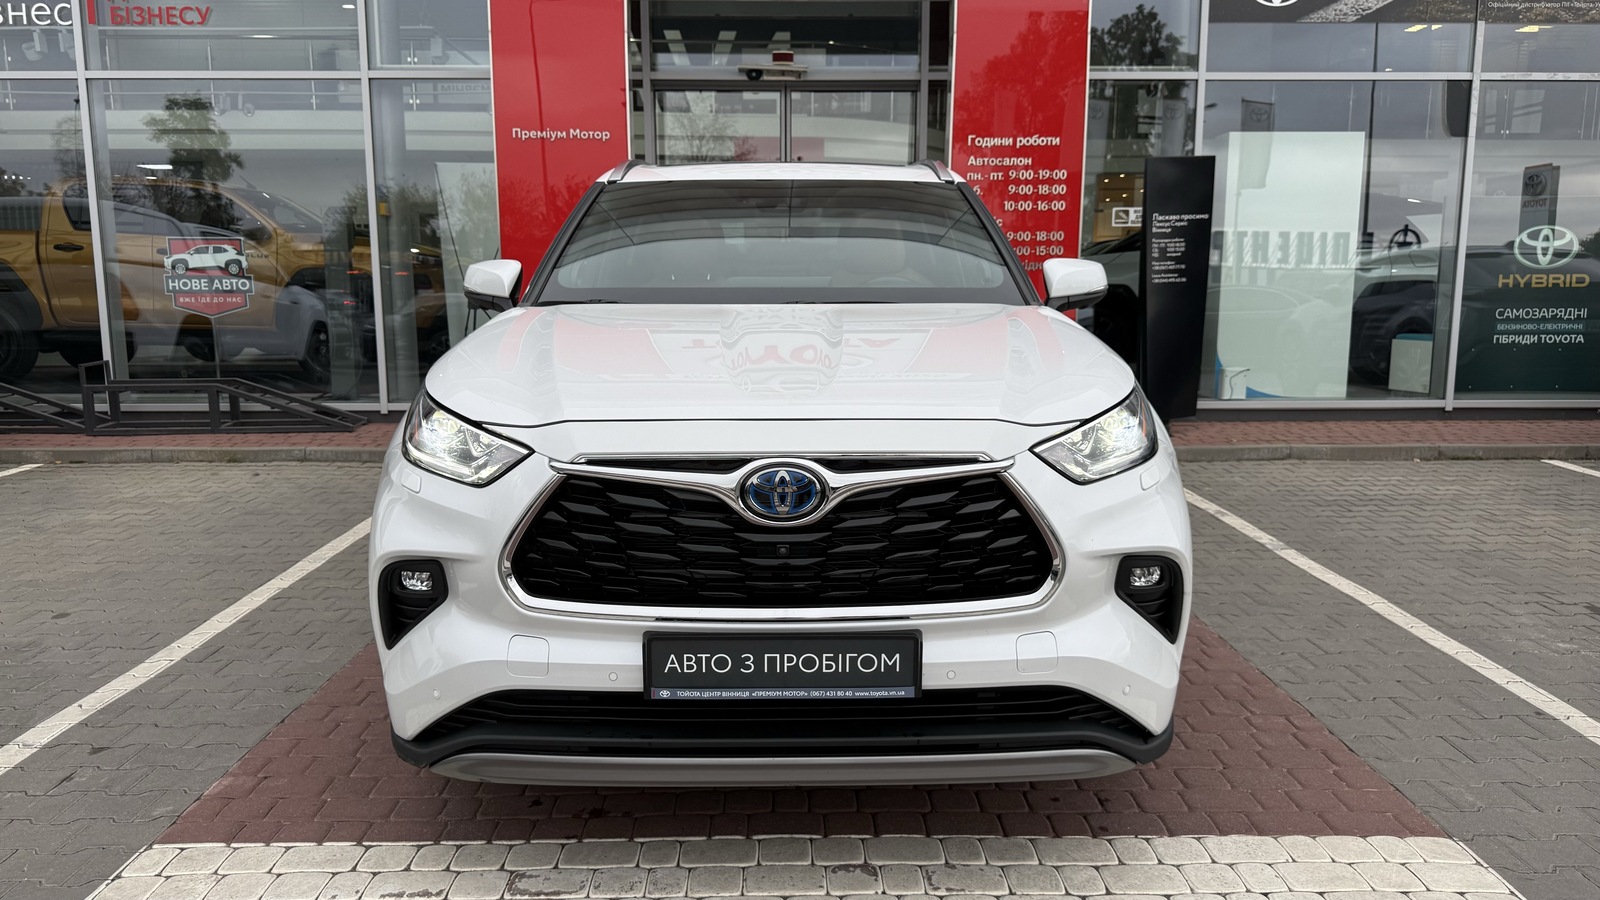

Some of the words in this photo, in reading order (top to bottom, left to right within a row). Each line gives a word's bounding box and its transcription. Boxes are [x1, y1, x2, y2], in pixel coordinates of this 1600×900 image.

[0, 3, 73, 25] нес
[110, 6, 211, 25] БІЗНЕСУ
[512, 128, 566, 141] Преміум
[569, 128, 610, 141] Мотор
[967, 135, 1013, 147] Години
[1016, 135, 1060, 148] роботи
[968, 156, 1032, 166] Автосалон
[1009, 169, 1068, 180] 9:00-19:00
[972, 184, 983, 195] б.
[1008, 184, 1067, 195] 9:00-18:00
[1003, 200, 1066, 211] 10:00-16:00
[1181, 213, 1209, 221] просимо
[1006, 231, 1065, 242] 9:00-18:00
[1012, 245, 1064, 256] :00-15:00
[168, 279, 209, 291] НОВЕ
[212, 279, 250, 291] АВТО
[1498, 274, 1590, 288] HYBRID
[1495, 308, 1588, 320] САМОЗАРЯДНІ
[1497, 323, 1583, 331] БЕНЗИНОВО-ЕЛЕКТРИЧНІ
[1493, 334, 1537, 345] ГІБРИДИ
[1540, 334, 1584, 344] TOYOTA
[664, 654, 732, 673] АВТО
[764, 653, 901, 673] ПРОБІГОМ
[677, 690, 700, 698] ТОЙОТА
[810, 690, 825, 698] (067)
[855, 690, 905, 698] www.toyota.vn.ua
